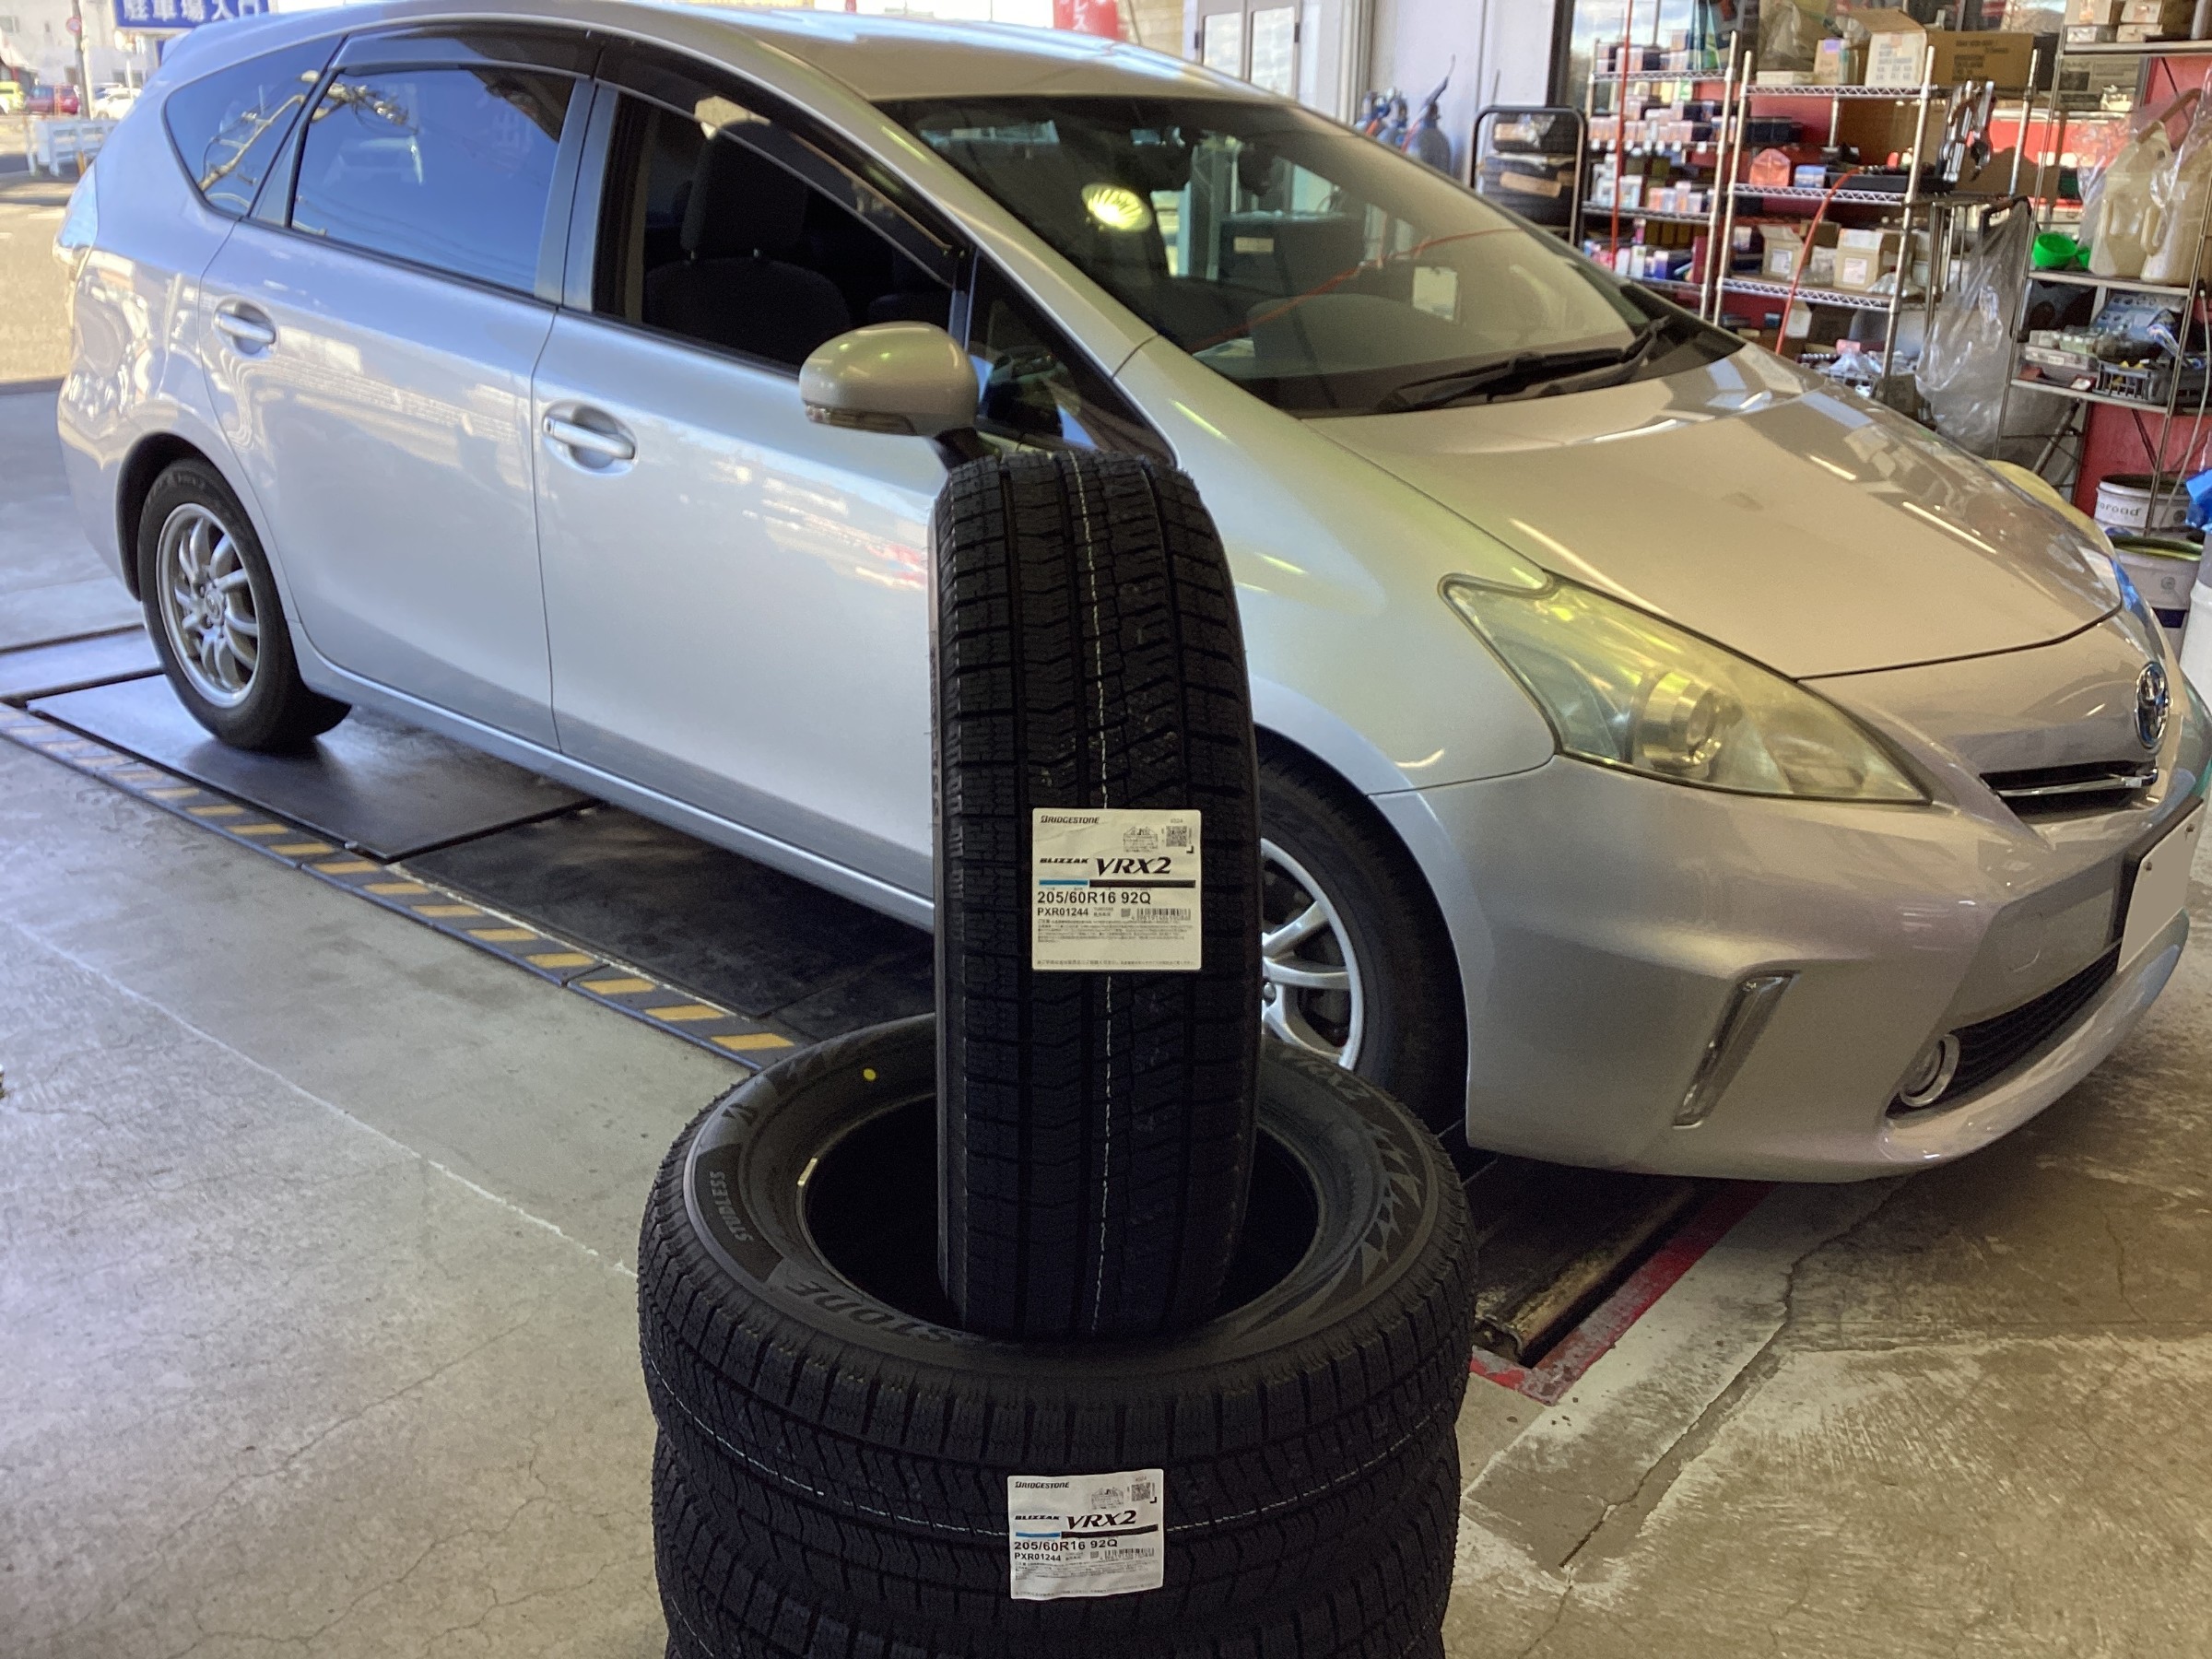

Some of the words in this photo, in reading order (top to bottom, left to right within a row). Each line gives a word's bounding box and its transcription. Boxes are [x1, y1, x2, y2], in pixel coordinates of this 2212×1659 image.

[1041, 816, 1099, 824] BRIDGESTONE
[1096, 856, 1171, 876] VRX2
[1038, 892, 1115, 904] 205/60R16
[1122, 892, 1151, 904] 92Q
[1038, 908, 1088, 916] PXR01244
[709, 1171, 755, 1241] STUDLESS
[1066, 1510, 1136, 1530] VRX2
[1015, 1541, 1086, 1551] 205/60R16
[1090, 1539, 1118, 1548] 92Q
[1015, 1552, 1061, 1561] PXR01244
